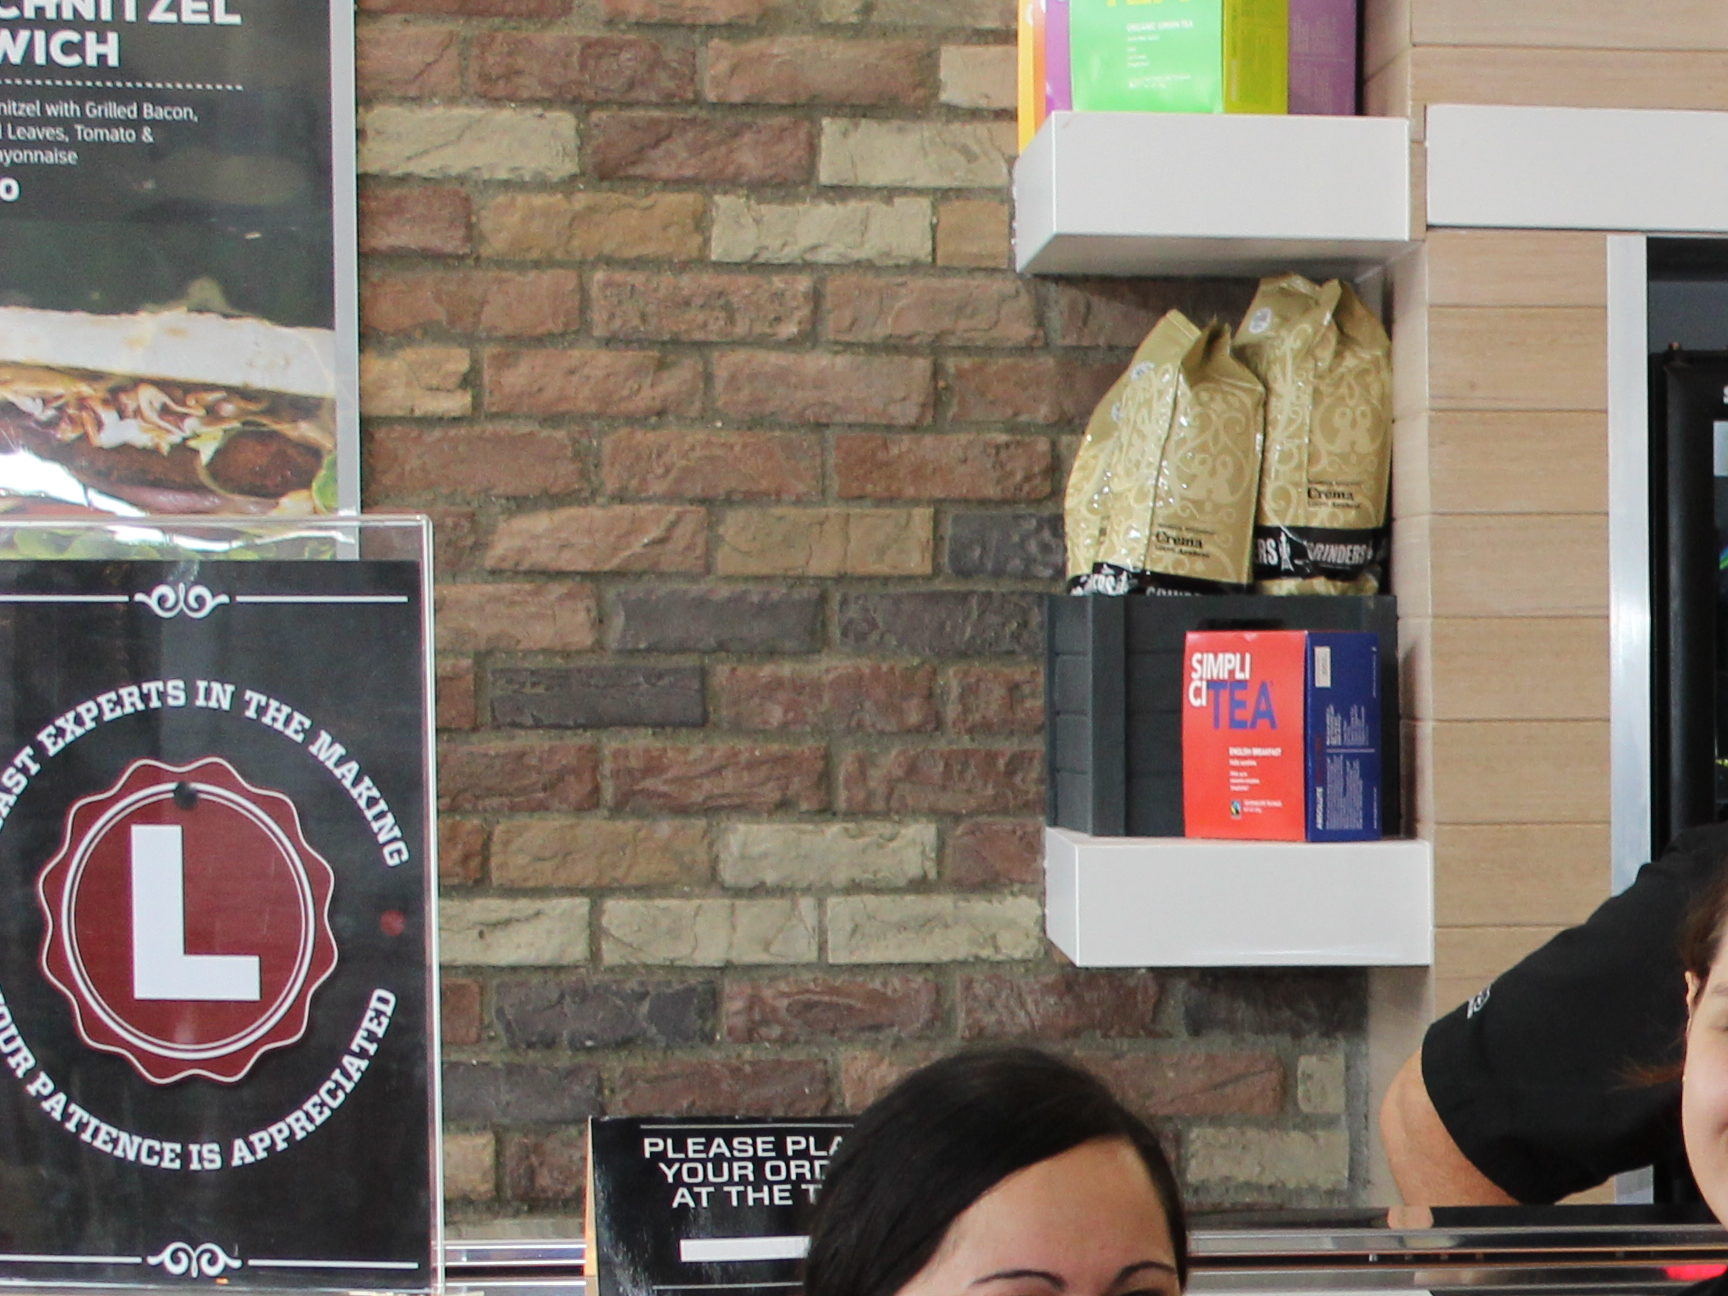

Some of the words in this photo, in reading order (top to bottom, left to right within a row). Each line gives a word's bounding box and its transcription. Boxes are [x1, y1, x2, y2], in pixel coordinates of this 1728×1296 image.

[46, 100, 81, 118] with
[85, 101, 137, 119] Grilled
[143, 102, 198, 122] Bacon,
[7, 123, 69, 142] Leaves,
[74, 124, 136, 143] Tomato
[141, 126, 154, 143] &
[0, 147, 79, 167] yonnaise
[1306, 487, 1354, 501] Crema
[1155, 531, 1204, 550] Crema
[1191, 652, 1251, 681] SIMPLI
[37, 679, 186, 757] EXPERTS
[194, 680, 235, 711] IN
[243, 689, 312, 744] THE
[308, 730, 410, 867] MAKING
[131, 824, 261, 1001] L
[27, 1071, 182, 1171] PATIENCE
[188, 1143, 222, 1172] IS
[231, 987, 397, 1168] APPRECIATED
[643, 1136, 777, 1159] PLEASE
[658, 1161, 754, 1183] YOUR
[671, 1186, 715, 1209] AT
[723, 1184, 793, 1207] THE
